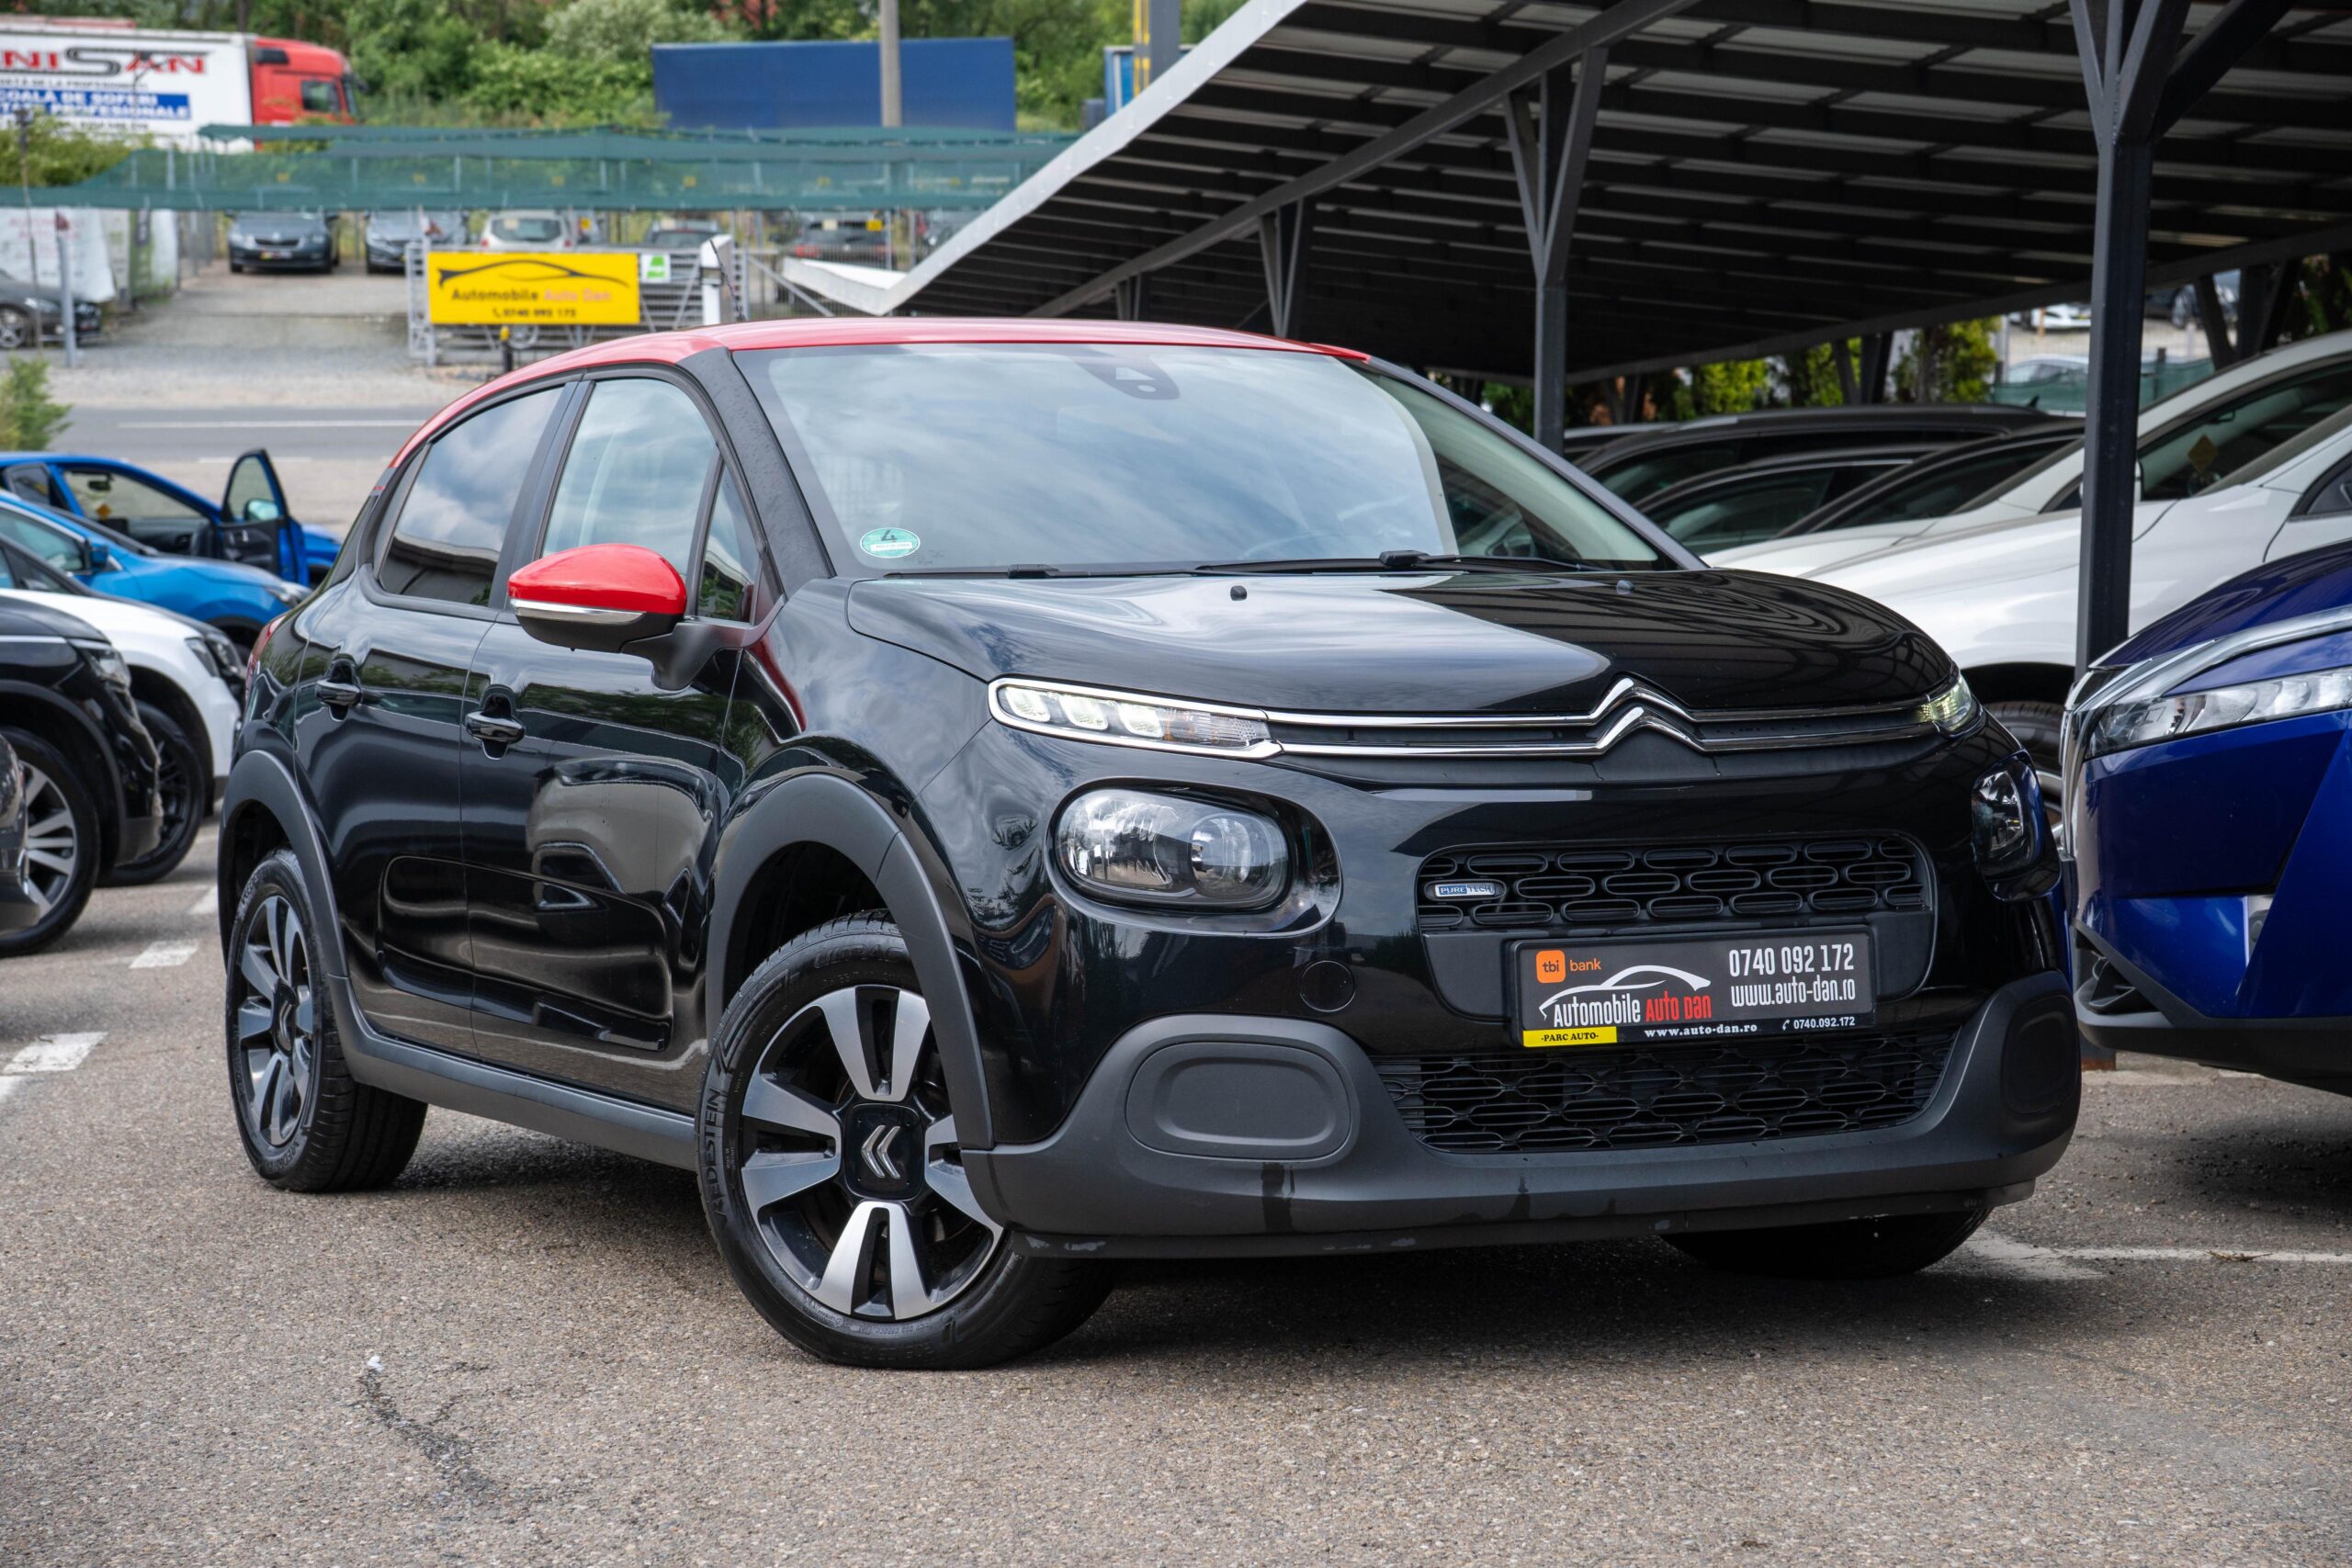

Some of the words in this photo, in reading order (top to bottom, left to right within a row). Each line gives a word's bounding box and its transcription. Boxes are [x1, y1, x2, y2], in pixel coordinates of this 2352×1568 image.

[451, 288, 538, 301] Automobile
[1542, 960, 1560, 973] tbi
[1569, 957, 1602, 972] bank
[1728, 947, 1776, 977] 0740
[1781, 945, 1815, 975] 092
[1820, 942, 1855, 972] 172
[1730, 974, 1856, 1008] www.auto-dan.ro
[1554, 992, 1641, 1028] Automobile
[1644, 1022, 1758, 1038] www.auto-dan.ro
[1792, 1016, 1856, 1030] 0740.092.172
